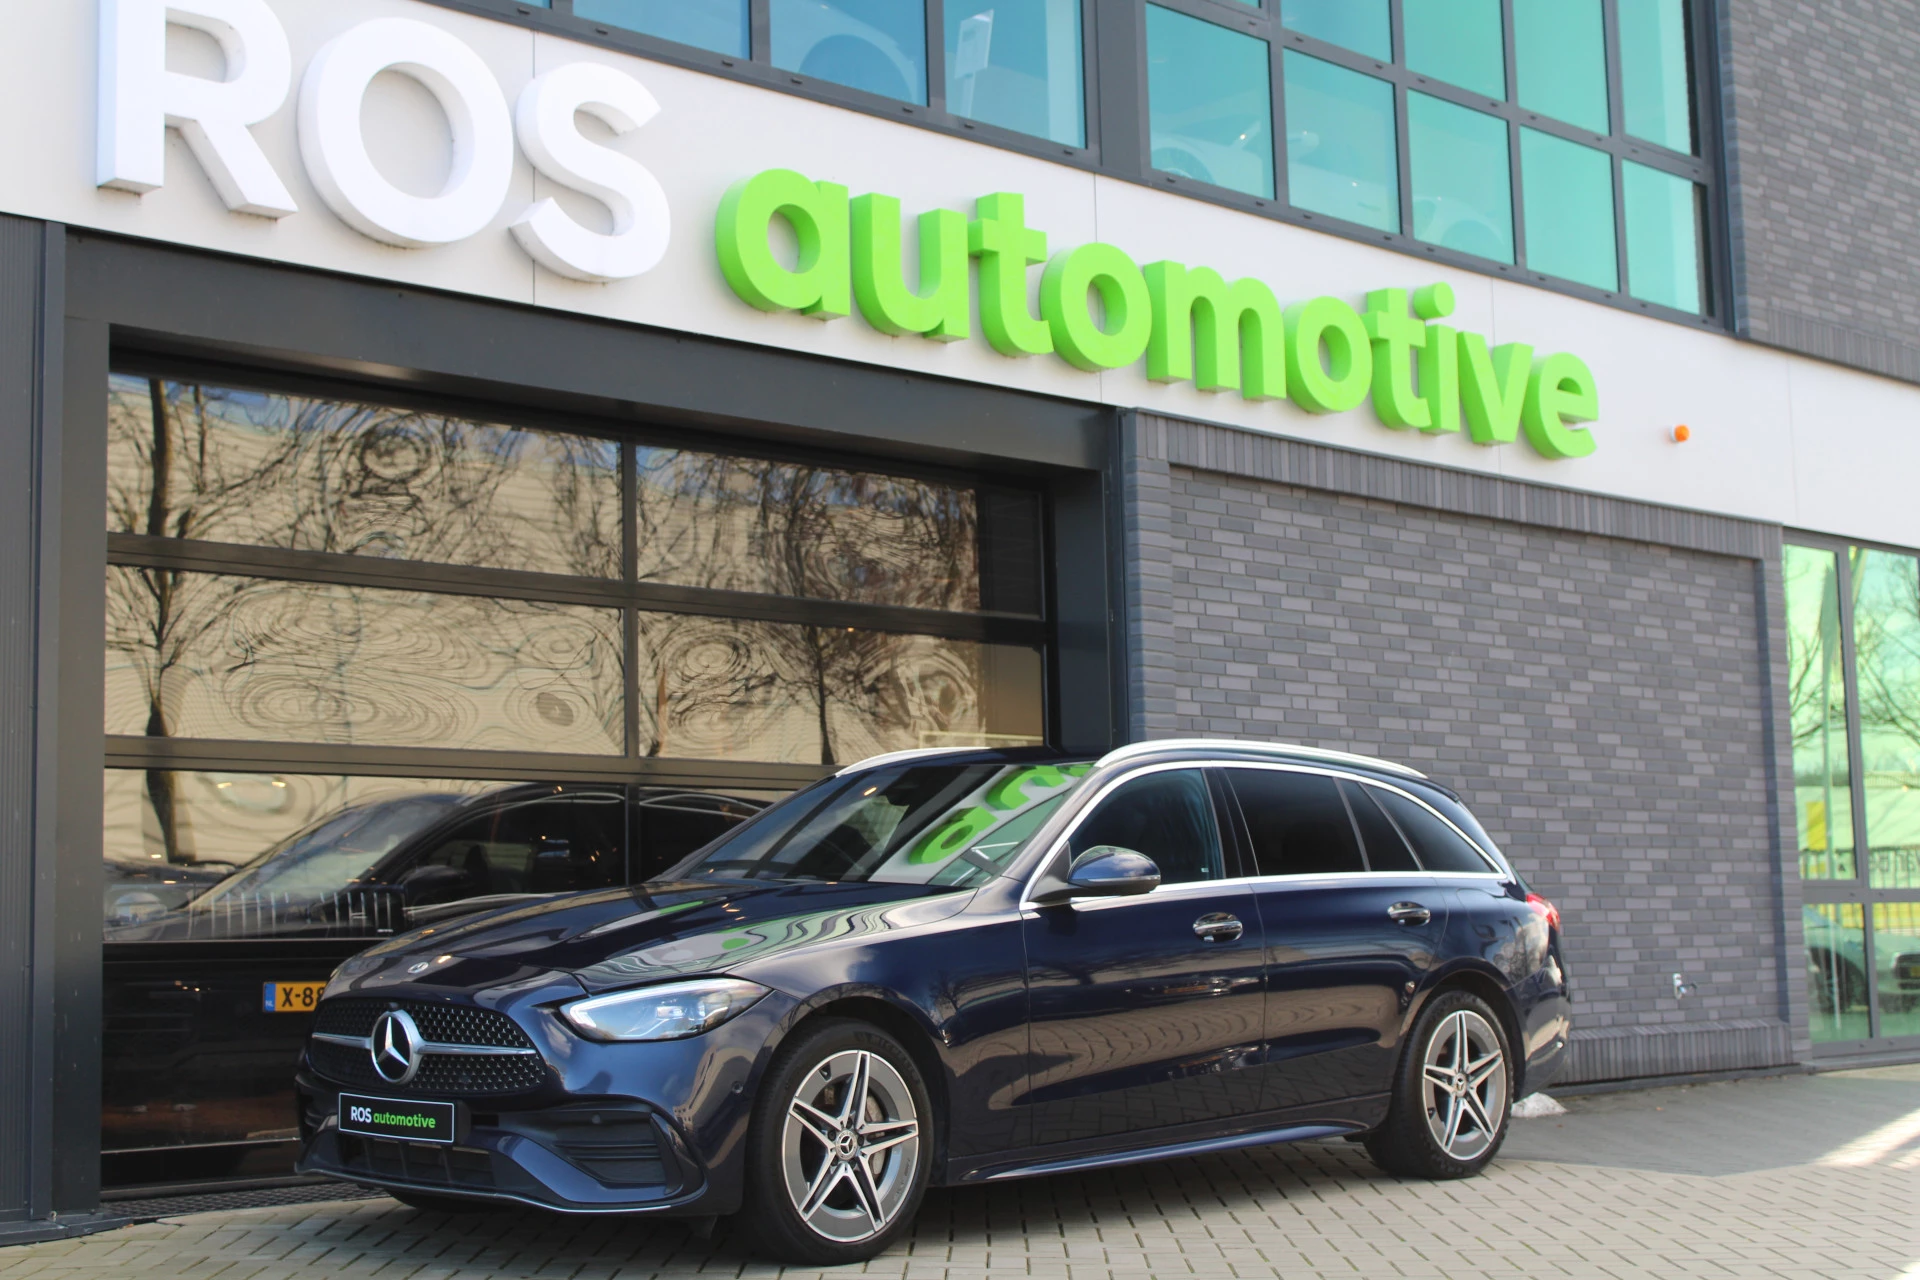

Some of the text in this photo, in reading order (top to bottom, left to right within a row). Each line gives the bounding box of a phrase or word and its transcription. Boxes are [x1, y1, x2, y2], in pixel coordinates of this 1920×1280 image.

[97, 0, 1600, 459] ROS automotive
[350, 1106, 436, 1129] ROS automotive
